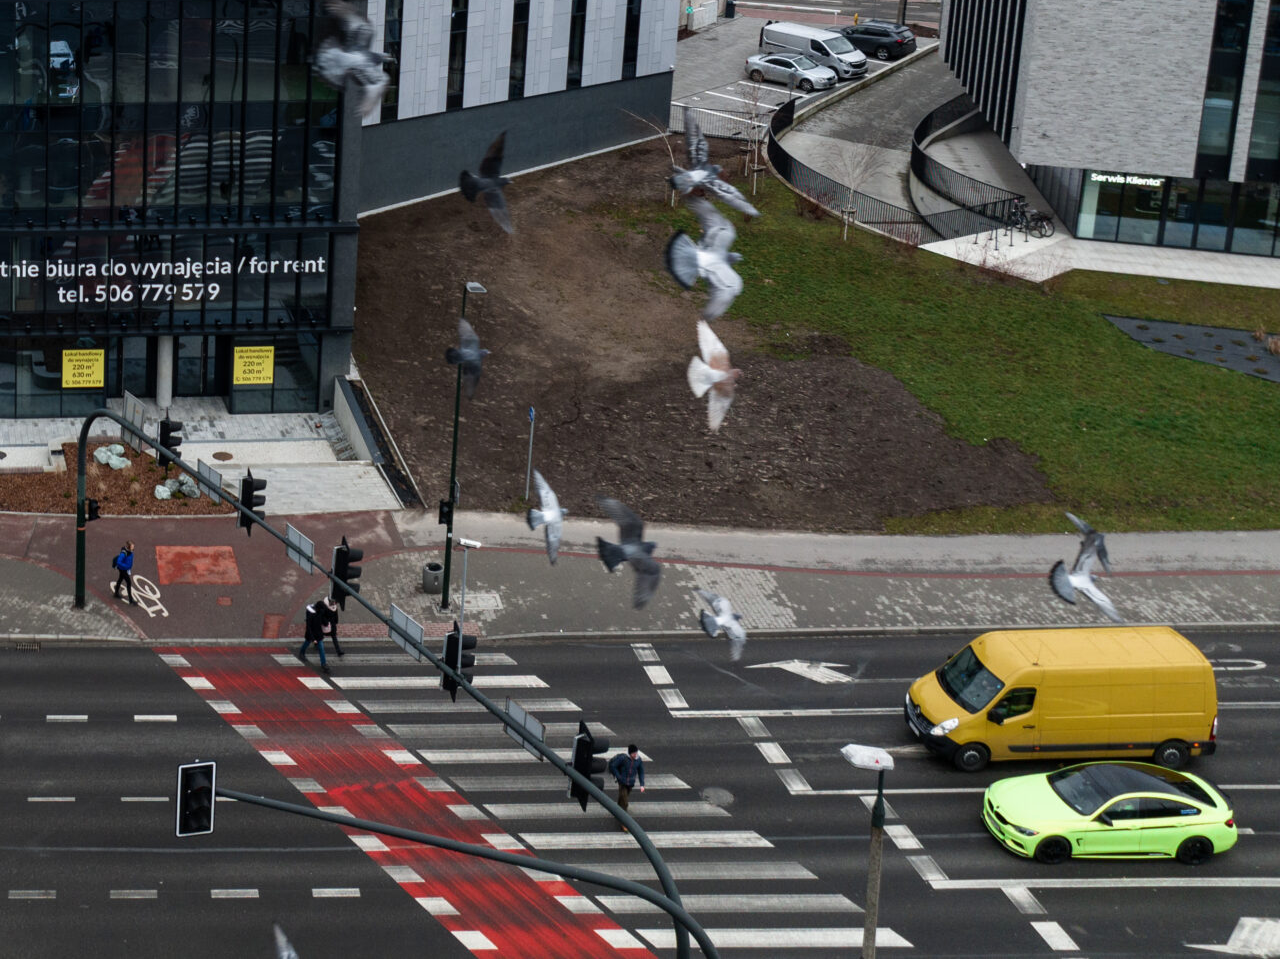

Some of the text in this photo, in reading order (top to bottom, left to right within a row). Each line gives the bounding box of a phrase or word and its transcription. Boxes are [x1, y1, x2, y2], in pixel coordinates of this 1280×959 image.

[1091, 173, 1162, 186] Serwis Klienta
[46, 259, 97, 277] biura
[101, 258, 127, 276] do
[131, 257, 232, 280] wynajęcia
[249, 256, 279, 274] for
[283, 256, 326, 273] rent
[57, 283, 220, 303] tel. 506 779 579
